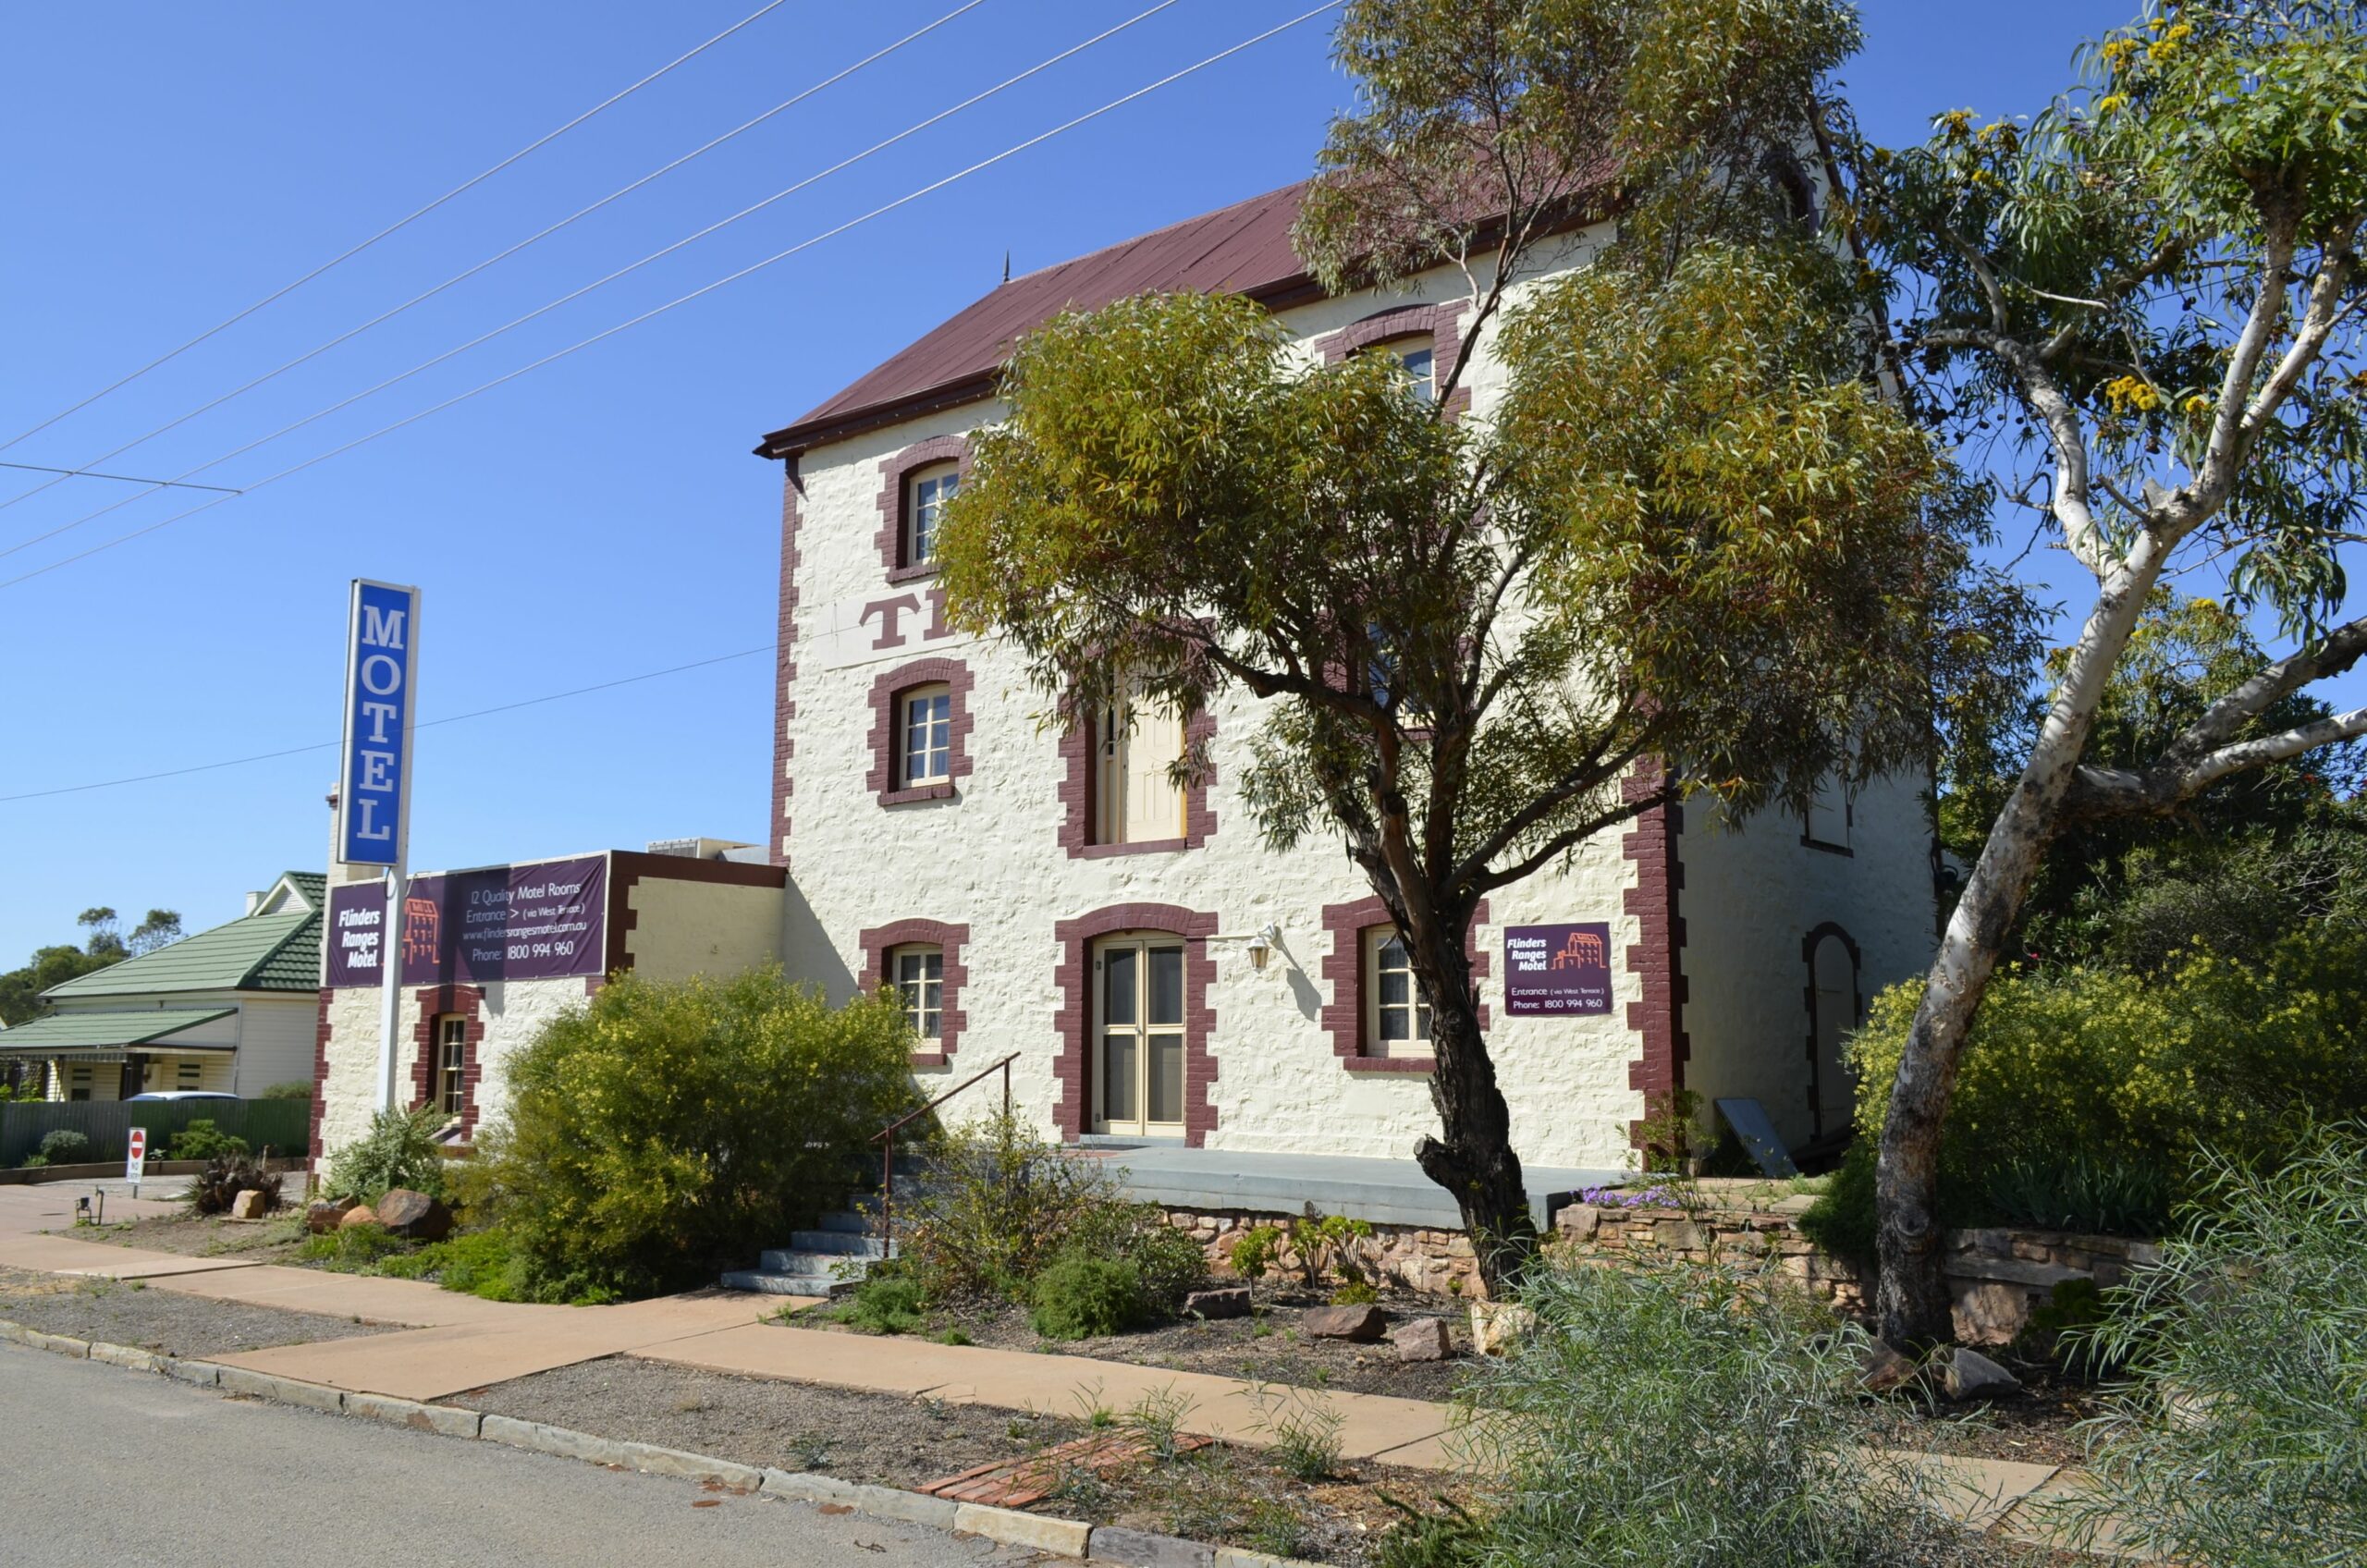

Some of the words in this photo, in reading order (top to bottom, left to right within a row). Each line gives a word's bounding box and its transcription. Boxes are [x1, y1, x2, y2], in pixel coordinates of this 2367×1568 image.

[356, 605, 406, 841] MOTEL
[471, 891, 480, 904] 12
[482, 888, 515, 905] Quality
[518, 884, 546, 900] Motel
[548, 882, 582, 897] Rooms
[338, 908, 381, 927] Flinders
[466, 910, 507, 924] Entrance
[538, 907, 556, 917] West
[462, 922, 587, 941] www.flindersrangesmotel.com.au
[341, 931, 380, 952] Ranges
[472, 949, 503, 962] Phone:
[507, 944, 530, 960] 1800
[532, 943, 550, 958] 994
[554, 940, 574, 956] 960
[1507, 937, 1547, 949] Flinders
[347, 949, 378, 969] Motel
[1512, 949, 1547, 962] Ranges
[1518, 961, 1547, 971] Motel
[1511, 987, 1548, 996] Entrance
[1513, 1000, 1540, 1010] Phone:
[1544, 999, 1564, 1009] 1800
[1566, 998, 1583, 1008] 994
[1586, 998, 1603, 1008] 960
